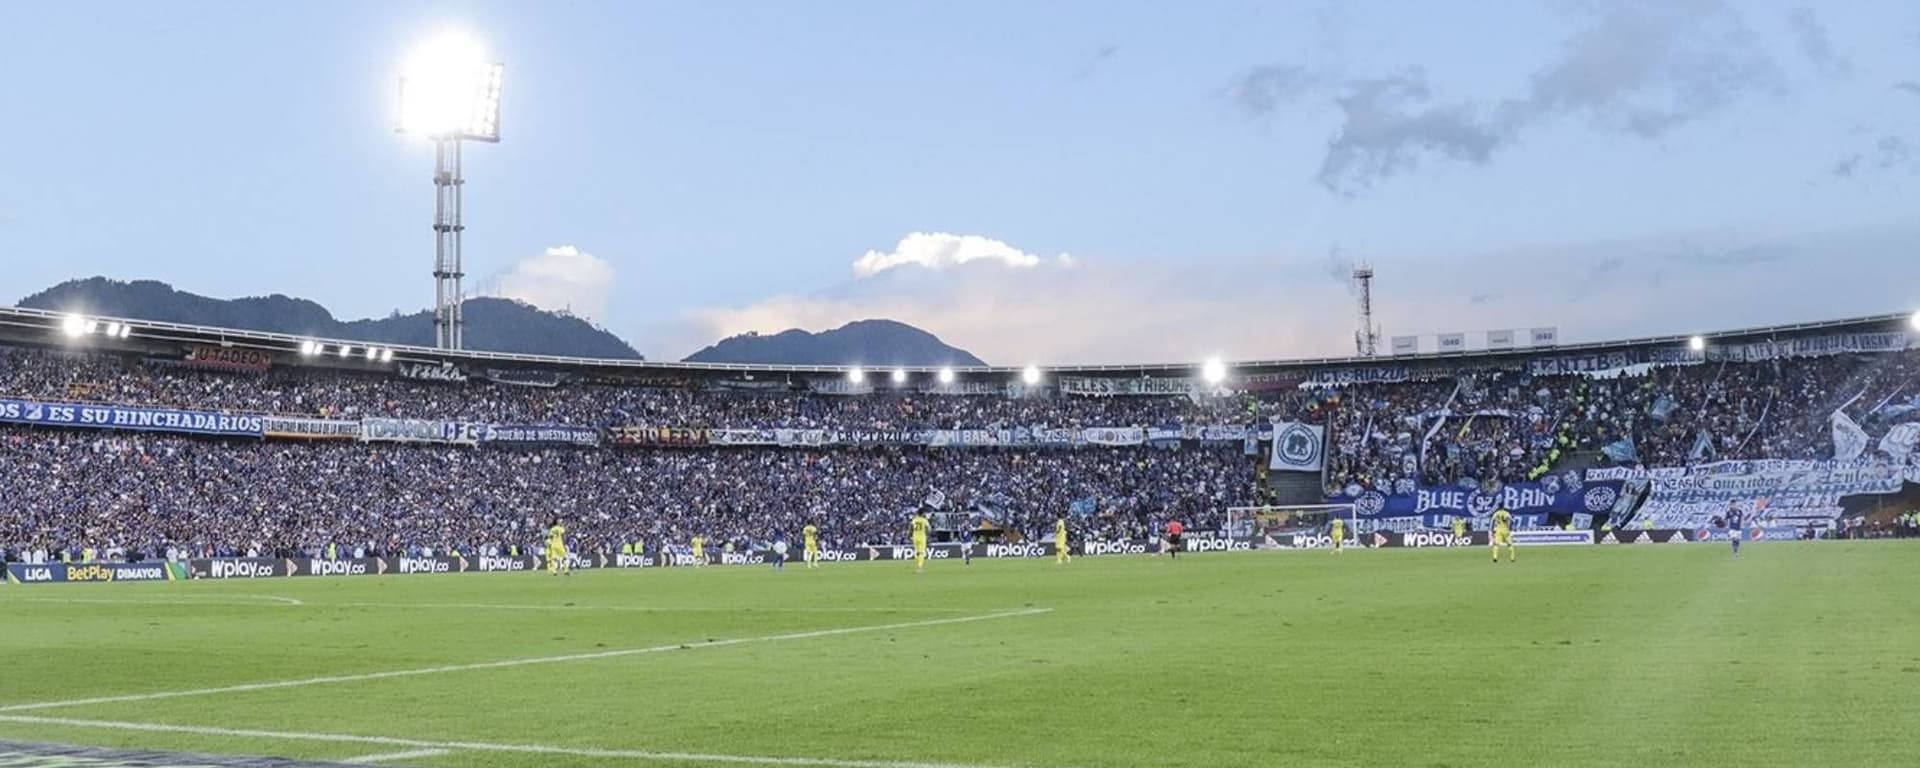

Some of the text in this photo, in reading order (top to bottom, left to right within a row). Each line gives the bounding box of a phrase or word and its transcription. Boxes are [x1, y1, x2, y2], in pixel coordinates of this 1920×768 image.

[48, 406, 75, 422] ES
[80, 408, 110, 423] SU
[526, 428, 537, 441] DE
[1414, 490, 1465, 513] BLUE
[1503, 486, 1555, 510] RAIN
[1084, 540, 1146, 555] Wplay.co
[1187, 537, 1250, 552] Wplay.co
[211, 559, 273, 578] Wplay.co
[311, 559, 366, 576] Wplay.co
[400, 557, 449, 574] Wplay.co
[479, 556, 524, 572] Wplay.co
[25, 566, 161, 582] LIGA BetPlay DIMAYOR
